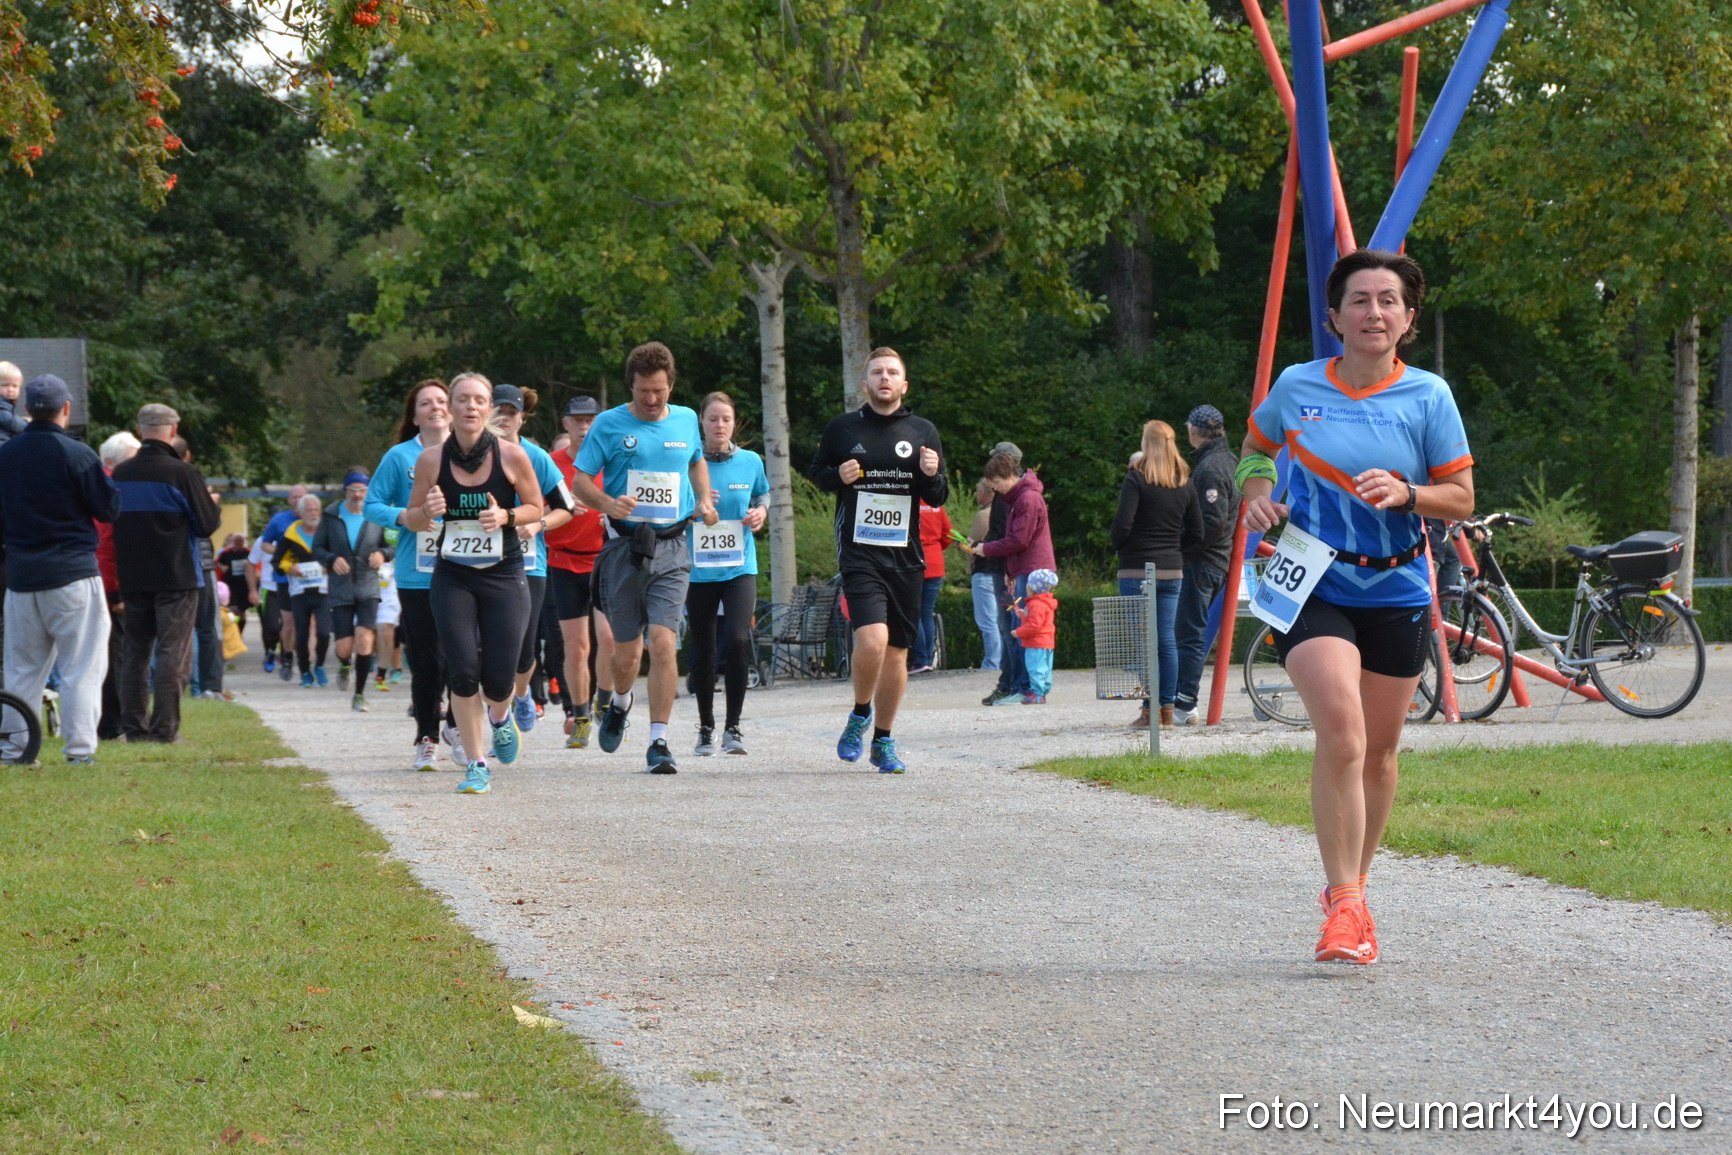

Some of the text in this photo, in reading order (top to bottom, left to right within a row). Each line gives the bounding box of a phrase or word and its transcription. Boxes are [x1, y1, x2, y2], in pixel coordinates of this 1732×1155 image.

[1326, 415, 1366, 425] Neumarkt
[1327, 407, 1385, 418] Raiffeisenbank
[460, 492, 488, 508] RUN
[635, 486, 672, 504] 2935
[864, 508, 902, 527] 2909
[858, 527, 899, 538] Alexander
[451, 537, 493, 553] 2724
[701, 534, 736, 549] 2138
